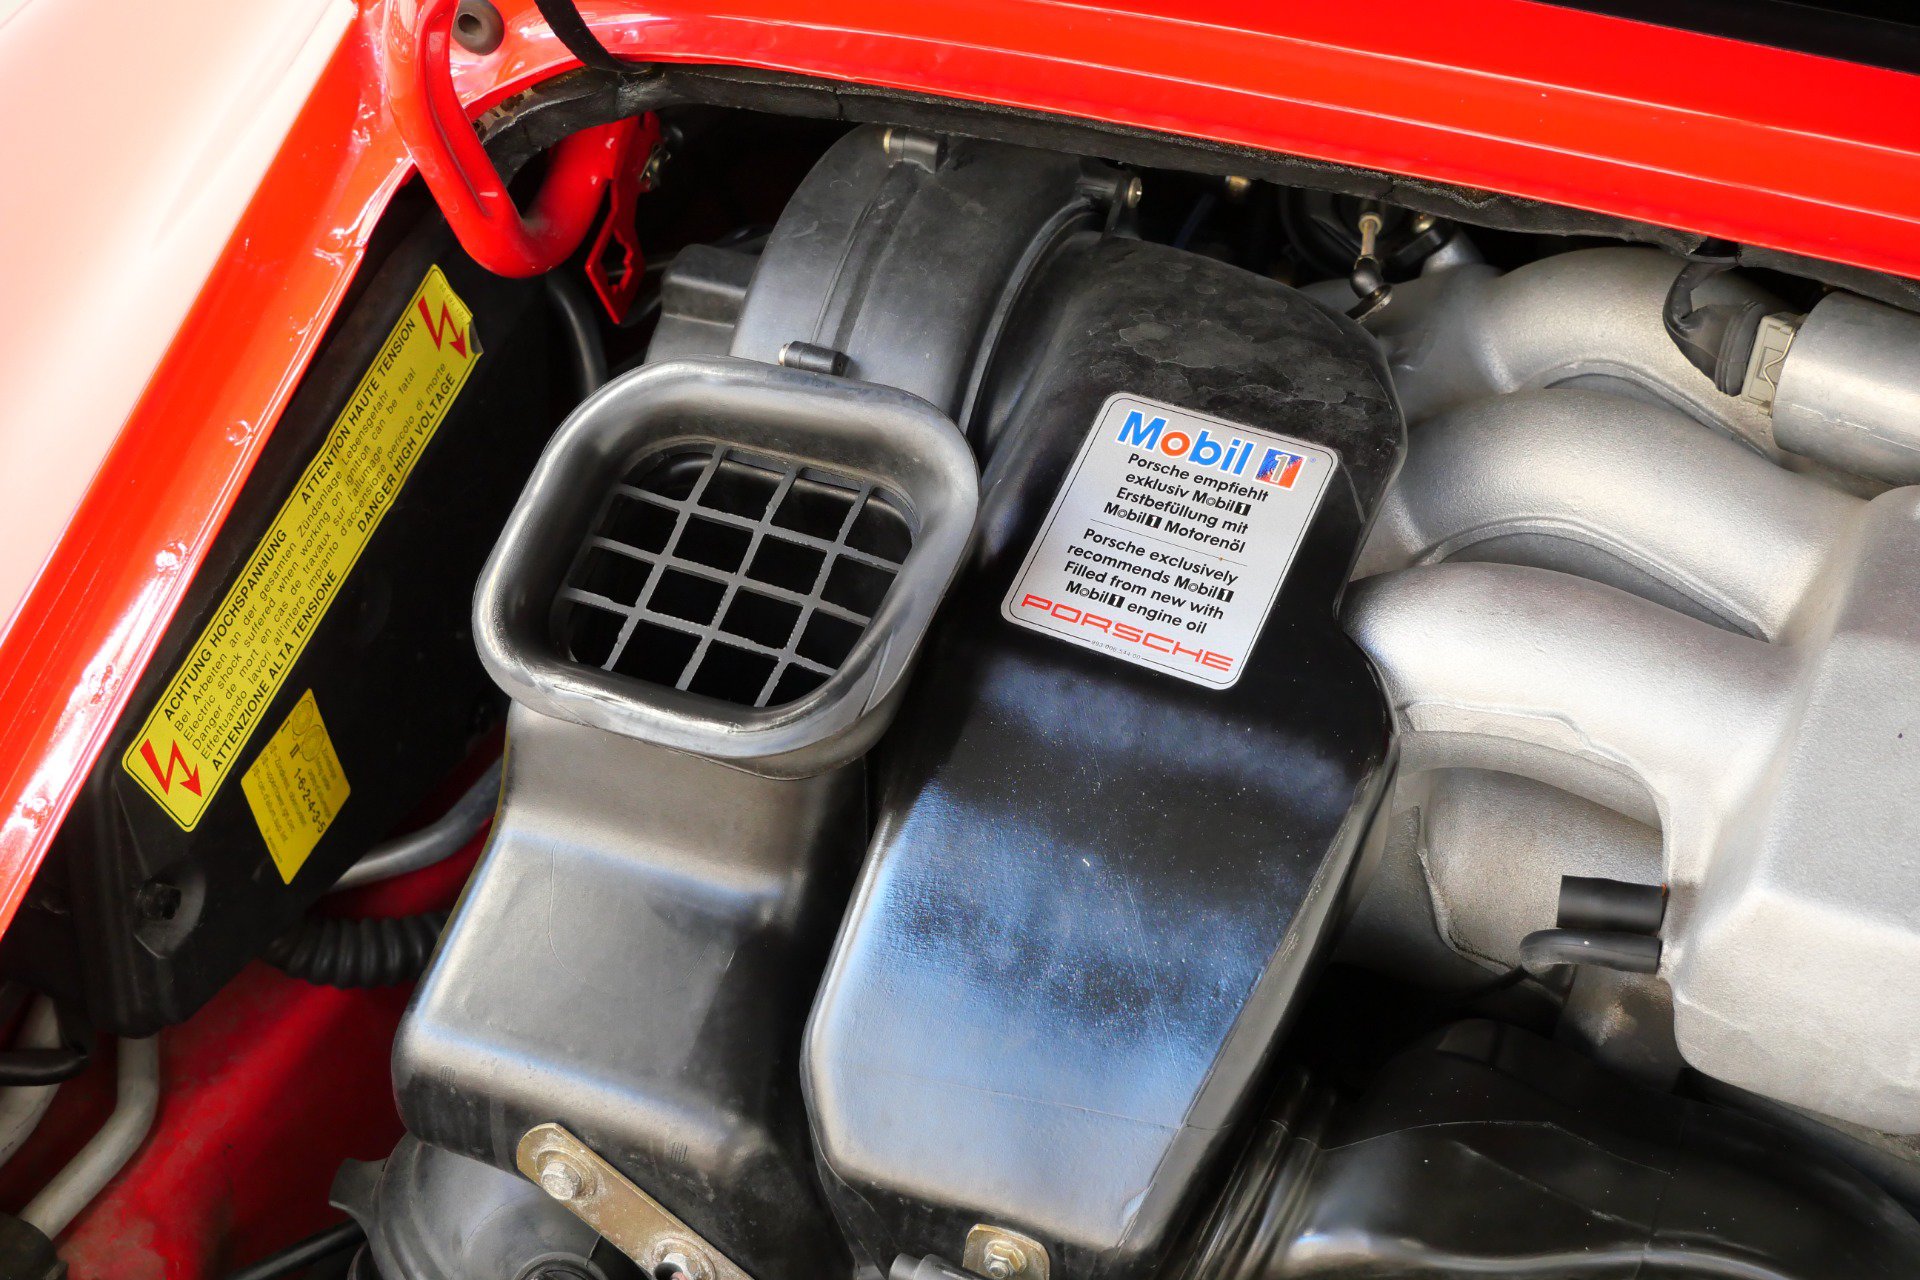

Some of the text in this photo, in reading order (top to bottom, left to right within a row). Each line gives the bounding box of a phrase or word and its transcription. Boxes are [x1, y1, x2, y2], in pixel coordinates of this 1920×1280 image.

[301, 317, 415, 504] ATTENTION HAUTE TENSION
[1117, 411, 1254, 474] Mobil
[357, 372, 455, 532] DANGER HIGH VOLTAGE
[1125, 473, 1189, 497] exklusiv
[1127, 452, 1268, 501] Porsche empfiehlt
[1116, 486, 1248, 534] Erstbefüllung mit
[1163, 519, 1245, 553] Motorenöl
[173, 389, 388, 735] Bei Arbeiten an der gesamten Zündanlage Lebensgefahr
[182, 367, 416, 741] Electric shock suffered when working on ignition can be fatal
[200, 363, 446, 759] Effettuando lavori all'intero impianto d'accensione pericolo di morte
[1066, 544, 1170, 583] recommends
[1083, 527, 1238, 586] Porsche exclusively
[191, 446, 382, 750] Danger de mort en cas de travaux sur l'allumage
[1063, 560, 1223, 619] Filled from new with
[1127, 603, 1182, 626] engine
[1186, 621, 1207, 634] oil
[164, 529, 286, 721] ACHTUNG HOCHSPANNUNG
[1021, 593, 1233, 671] PORSCHE
[212, 569, 337, 771] ATTENZIONE ALTA TENSIONE
[295, 768, 326, 834] 1-6-2-4-3-5
